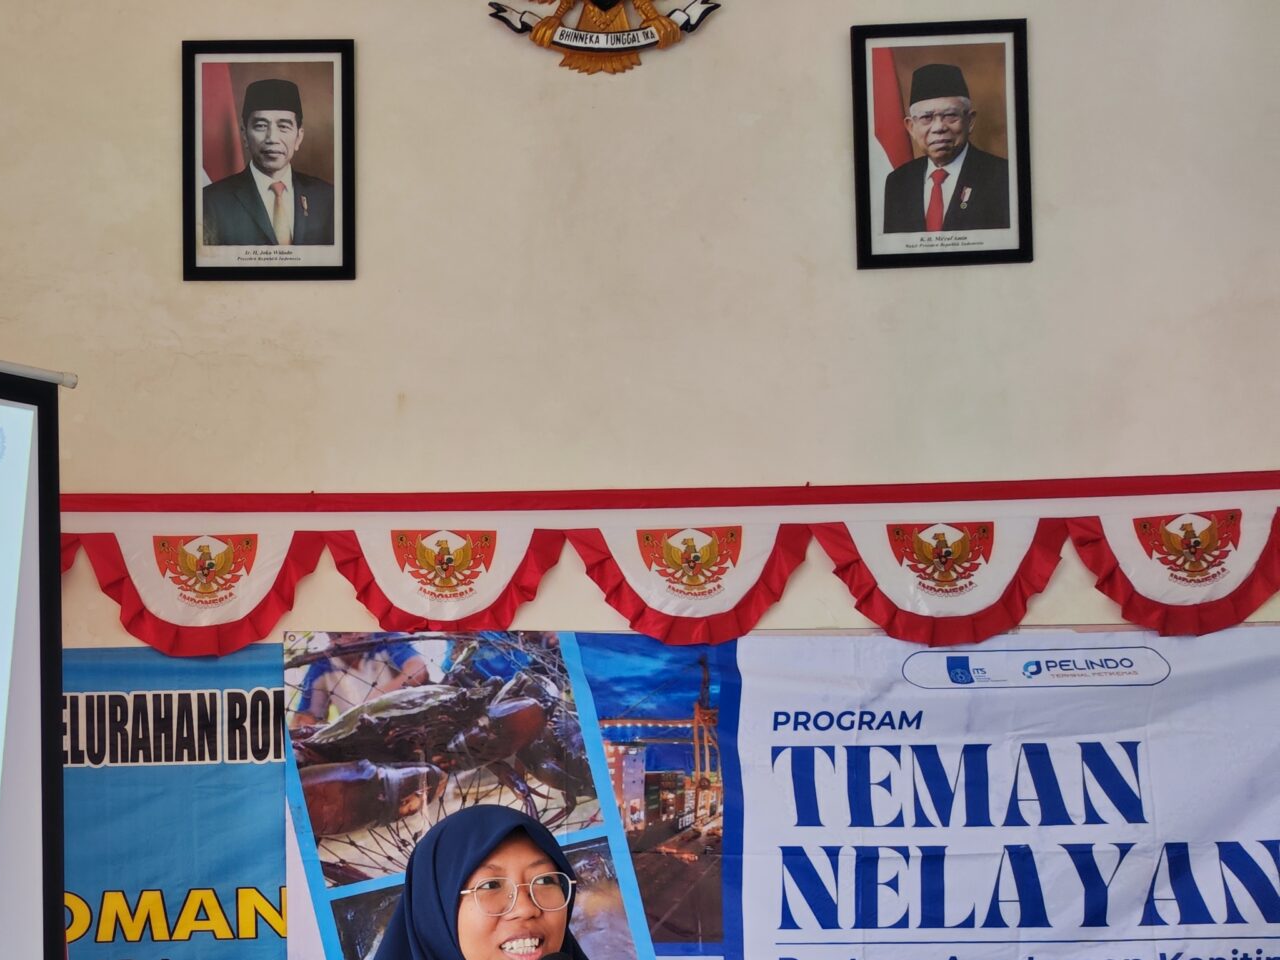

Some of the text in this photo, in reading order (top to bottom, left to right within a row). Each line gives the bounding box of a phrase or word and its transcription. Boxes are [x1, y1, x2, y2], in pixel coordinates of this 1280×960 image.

[558, 29, 656, 46] BHINNEKA TUNGGAL IKA
[1045, 657, 1134, 672] PELINDO
[772, 709, 924, 732] PROGRAM
[771, 740, 1149, 828] TEMAN
[778, 839, 1280, 930] NELAYAN
